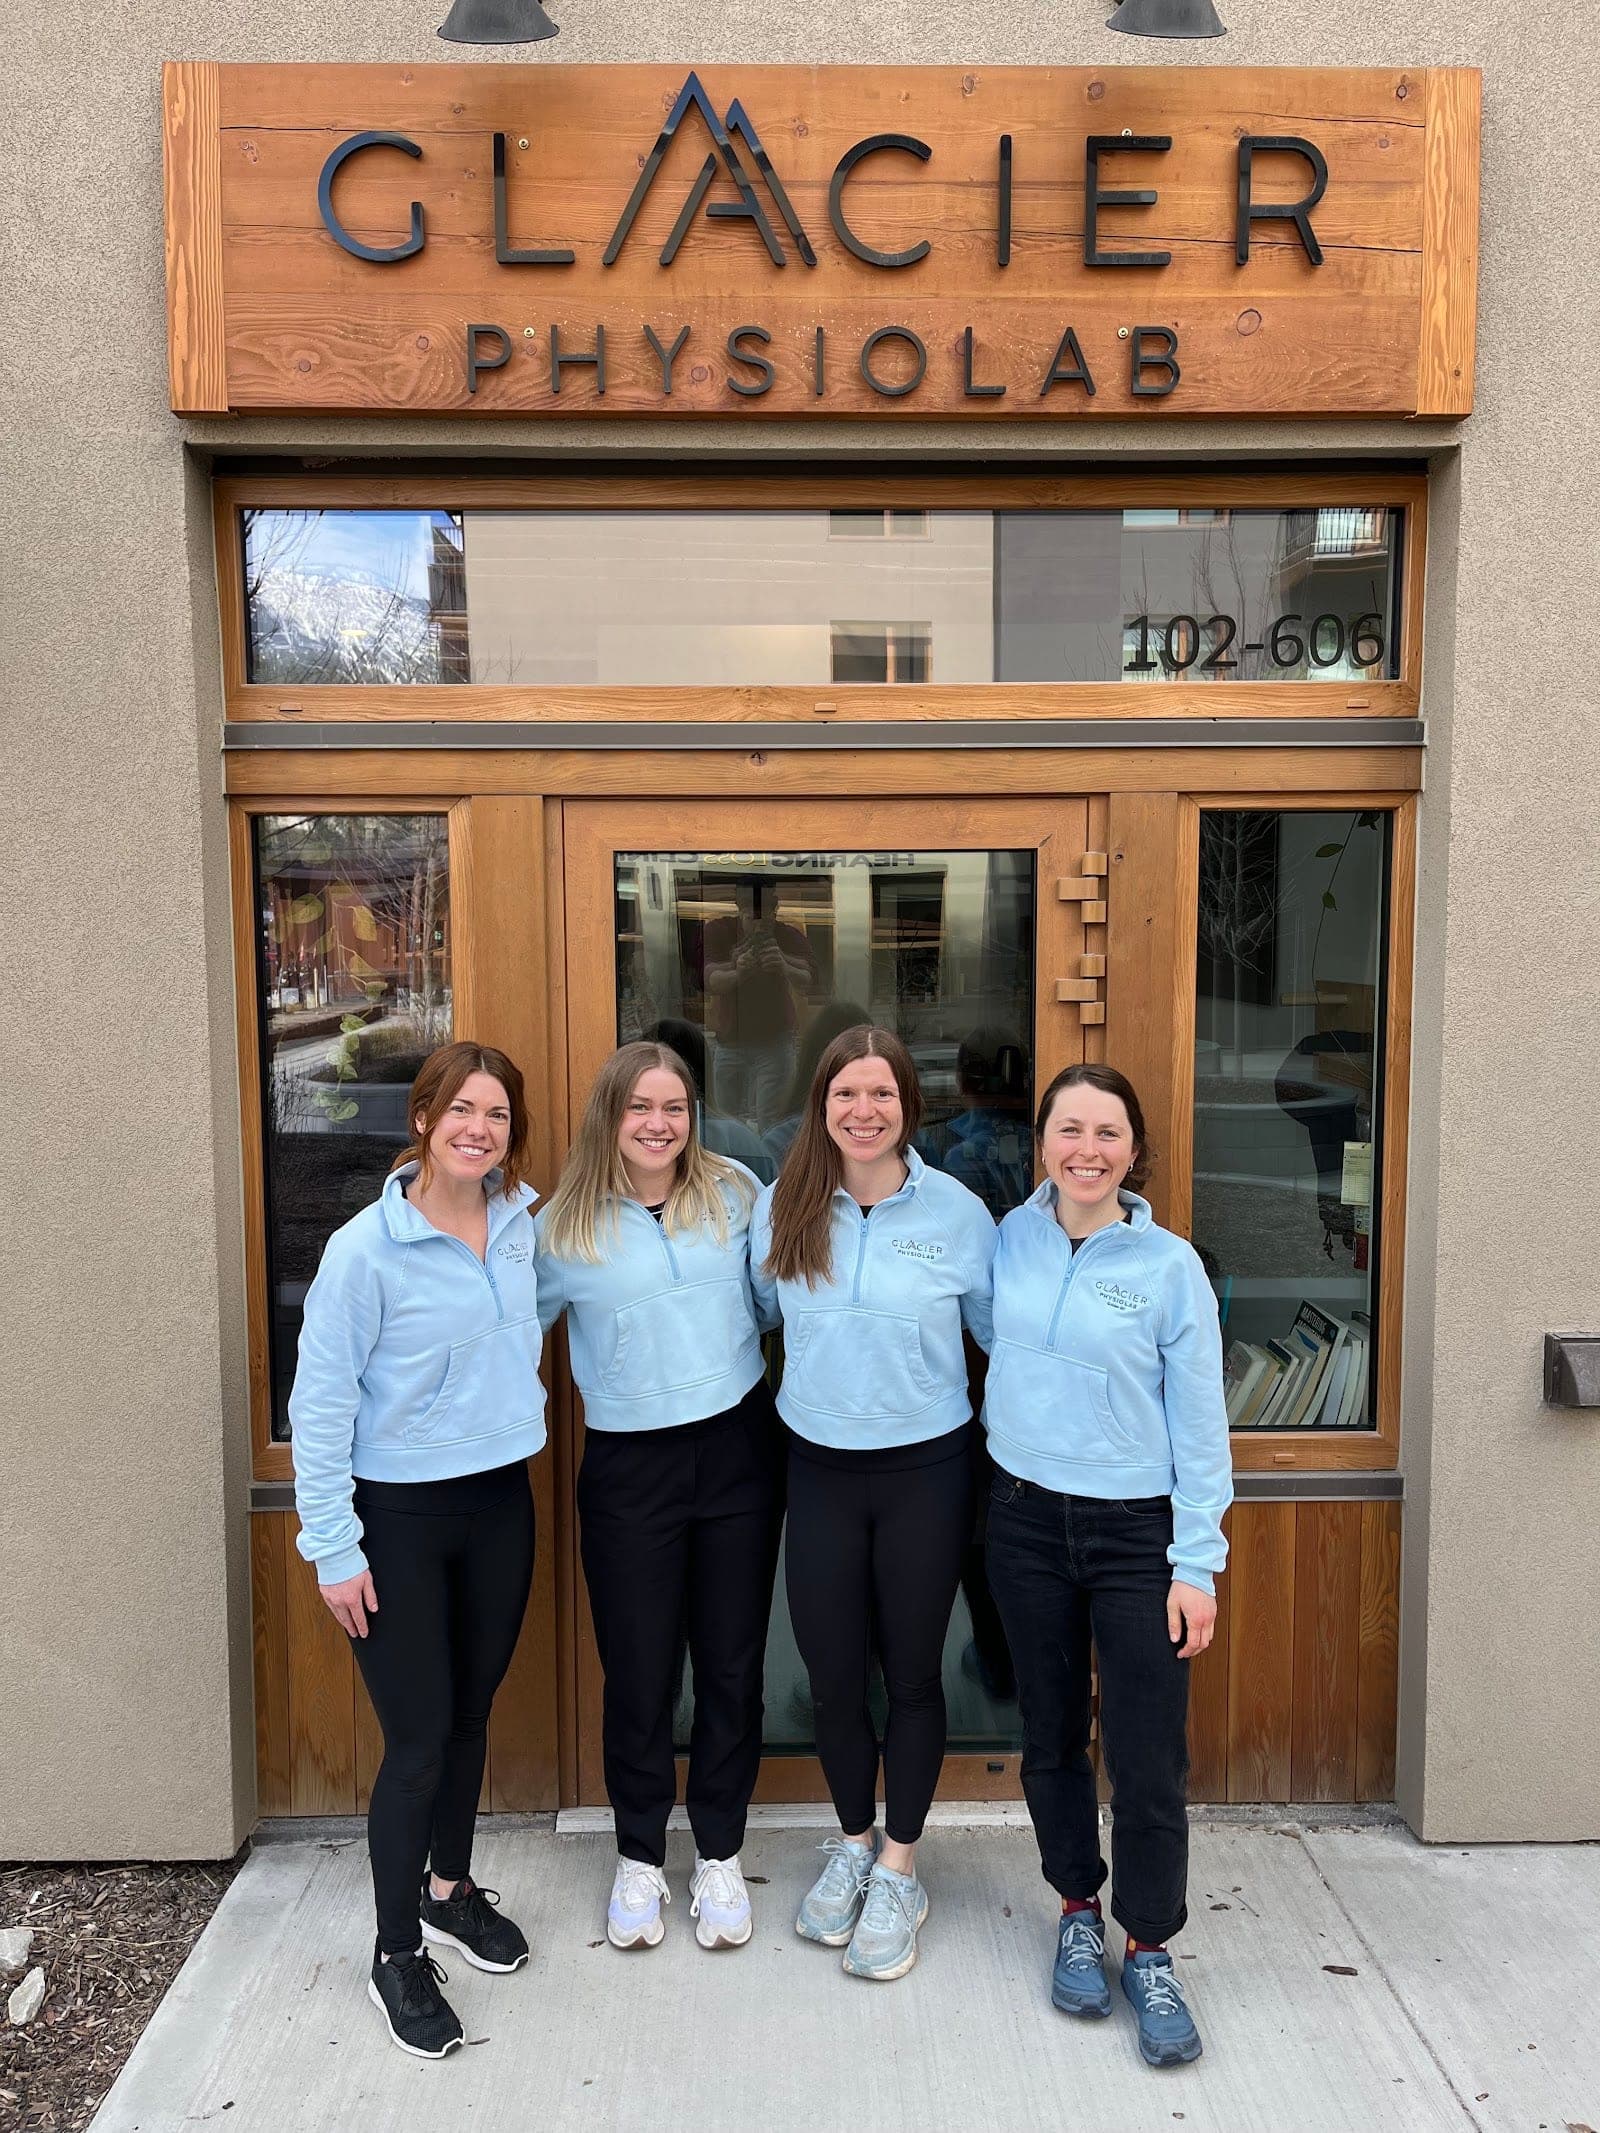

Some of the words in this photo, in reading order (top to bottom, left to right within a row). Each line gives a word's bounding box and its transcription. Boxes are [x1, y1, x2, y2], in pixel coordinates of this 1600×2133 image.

[317, 71, 1329, 268] GLACIER
[467, 324, 1181, 396] PHYSIOLAB
[1126, 613, 1385, 669] 102-606
[891, 1239, 943, 1255] GLACIER
[1095, 1281, 1148, 1305] GLACIER
